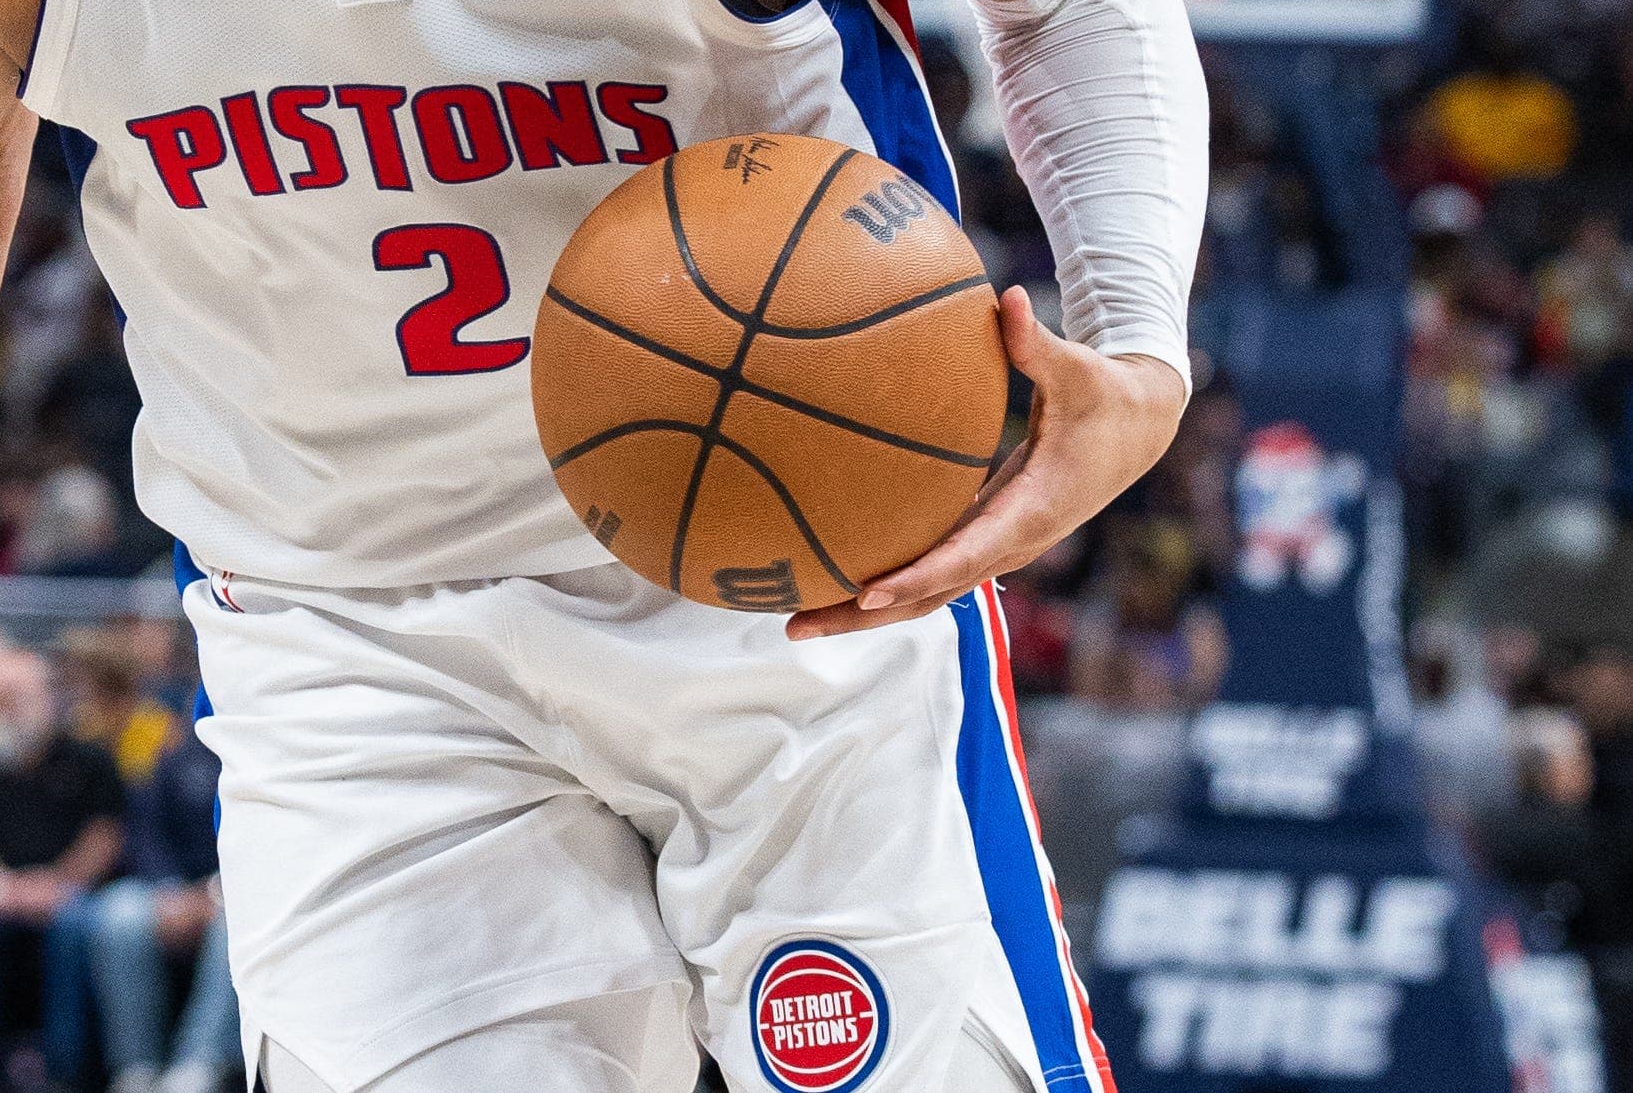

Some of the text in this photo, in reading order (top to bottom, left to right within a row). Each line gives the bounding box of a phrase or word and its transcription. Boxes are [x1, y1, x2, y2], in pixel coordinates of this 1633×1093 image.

[126, 80, 678, 209] PISTONS
[372, 222, 532, 377] 2
[1096, 867, 1457, 980] BELLE
[769, 990, 853, 1024] DETROIT
[772, 1016, 858, 1051] PISTONS
[1131, 972, 1403, 1079] TIRE
